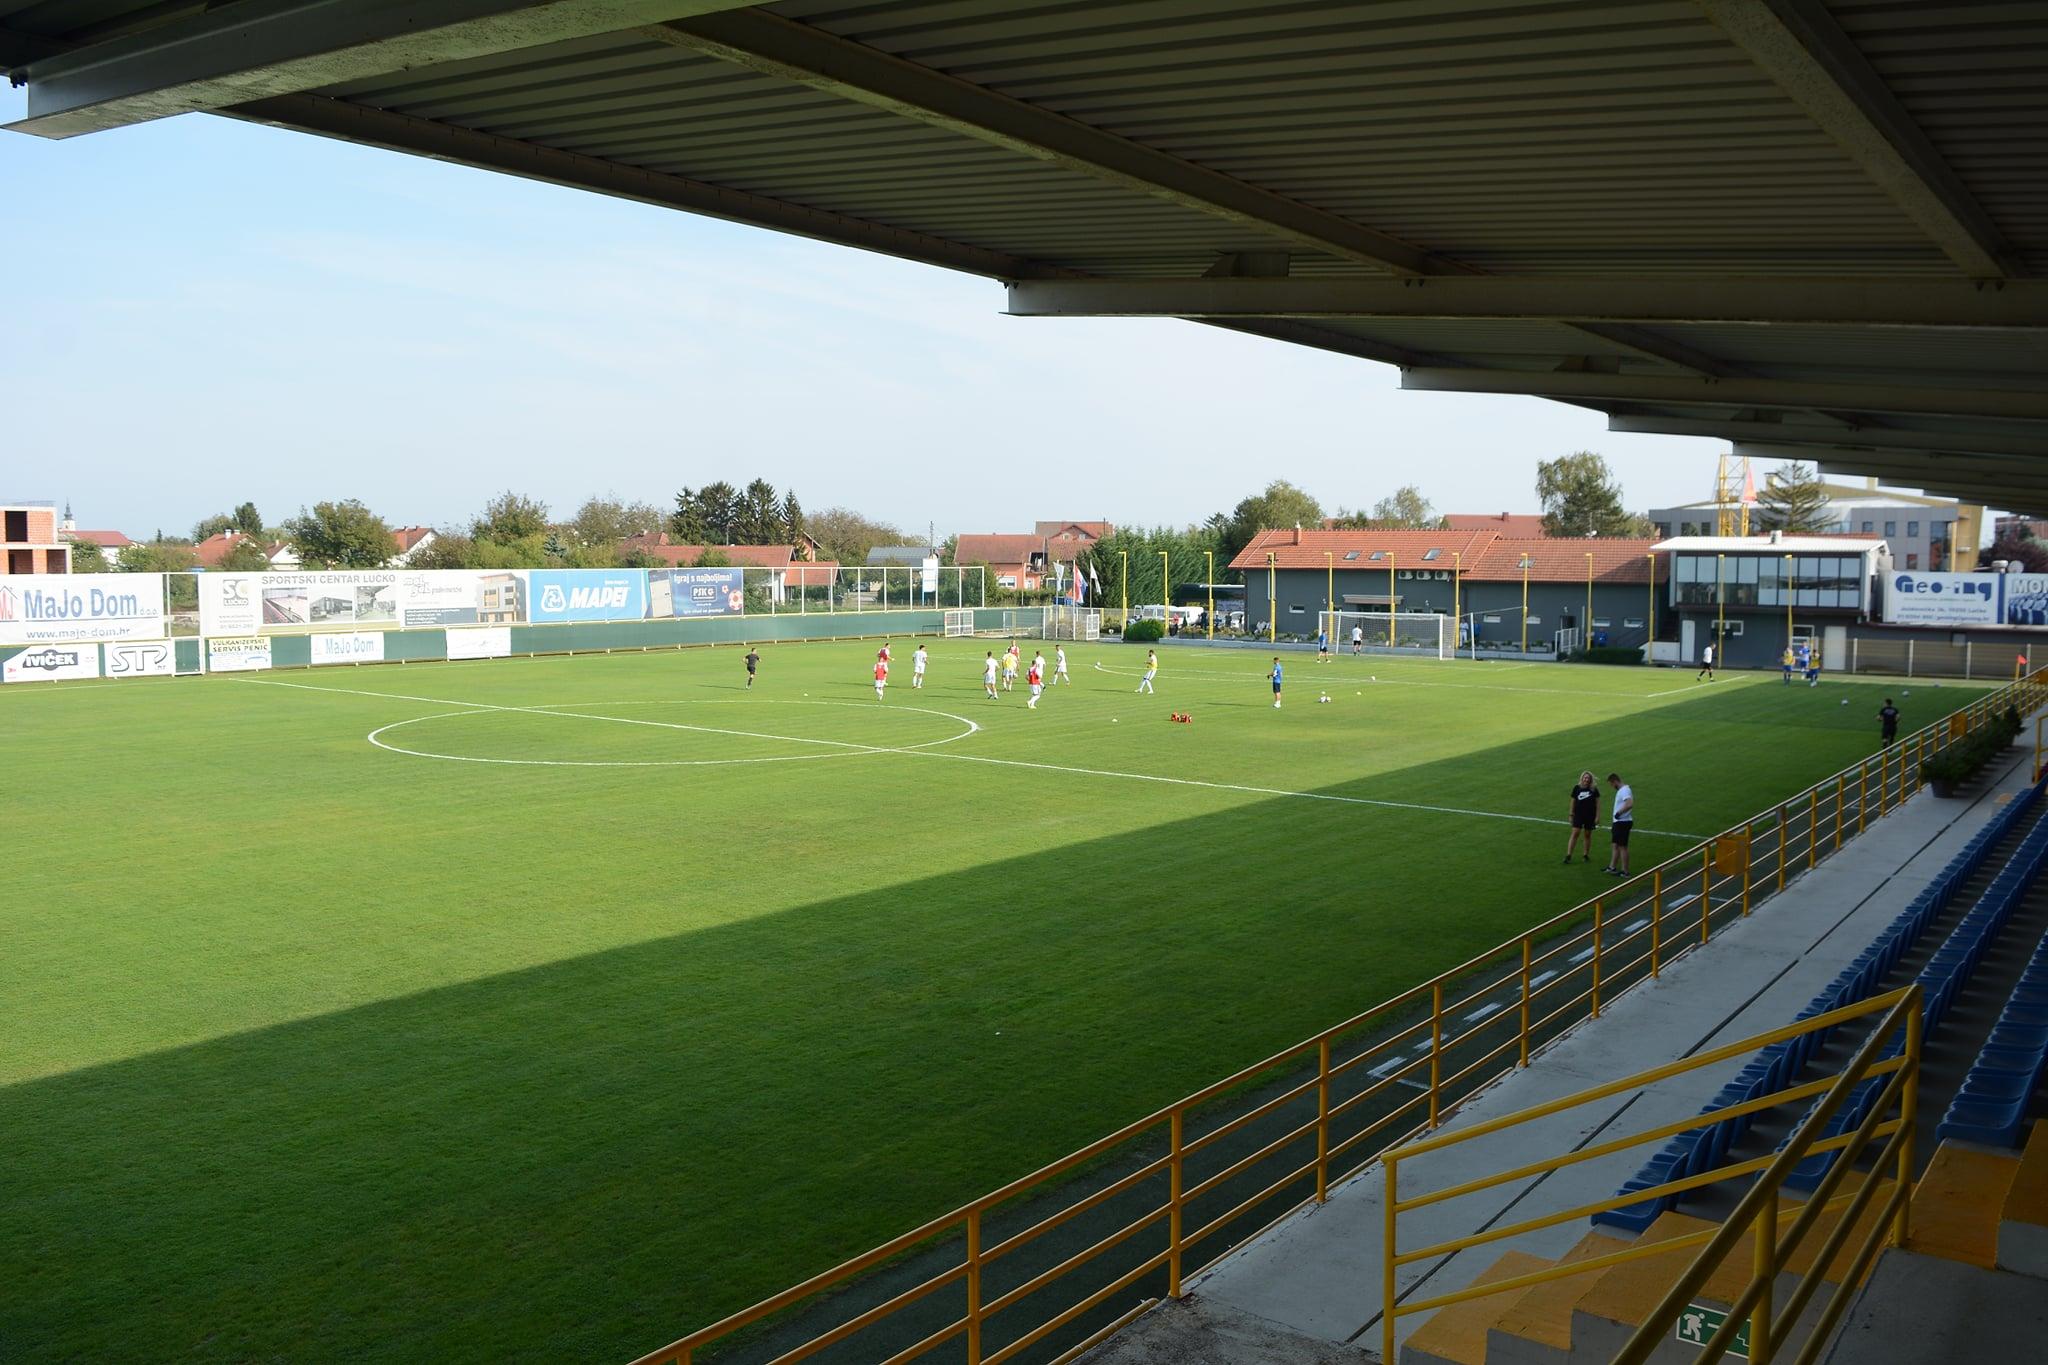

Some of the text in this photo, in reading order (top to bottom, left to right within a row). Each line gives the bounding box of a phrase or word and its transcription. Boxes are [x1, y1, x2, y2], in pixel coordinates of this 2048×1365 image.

[262, 575, 316, 585] SPORTSKI
[320, 575, 360, 584] CENTAR
[1895, 575, 1992, 602] Geo-ing
[24, 589, 83, 618] MaJo
[90, 588, 137, 617] Dom
[569, 587, 631, 608] MAPEI
[693, 588, 708, 597] PSK
[26, 628, 131, 640] www.majo-dom.hr
[111, 645, 168, 673] STP
